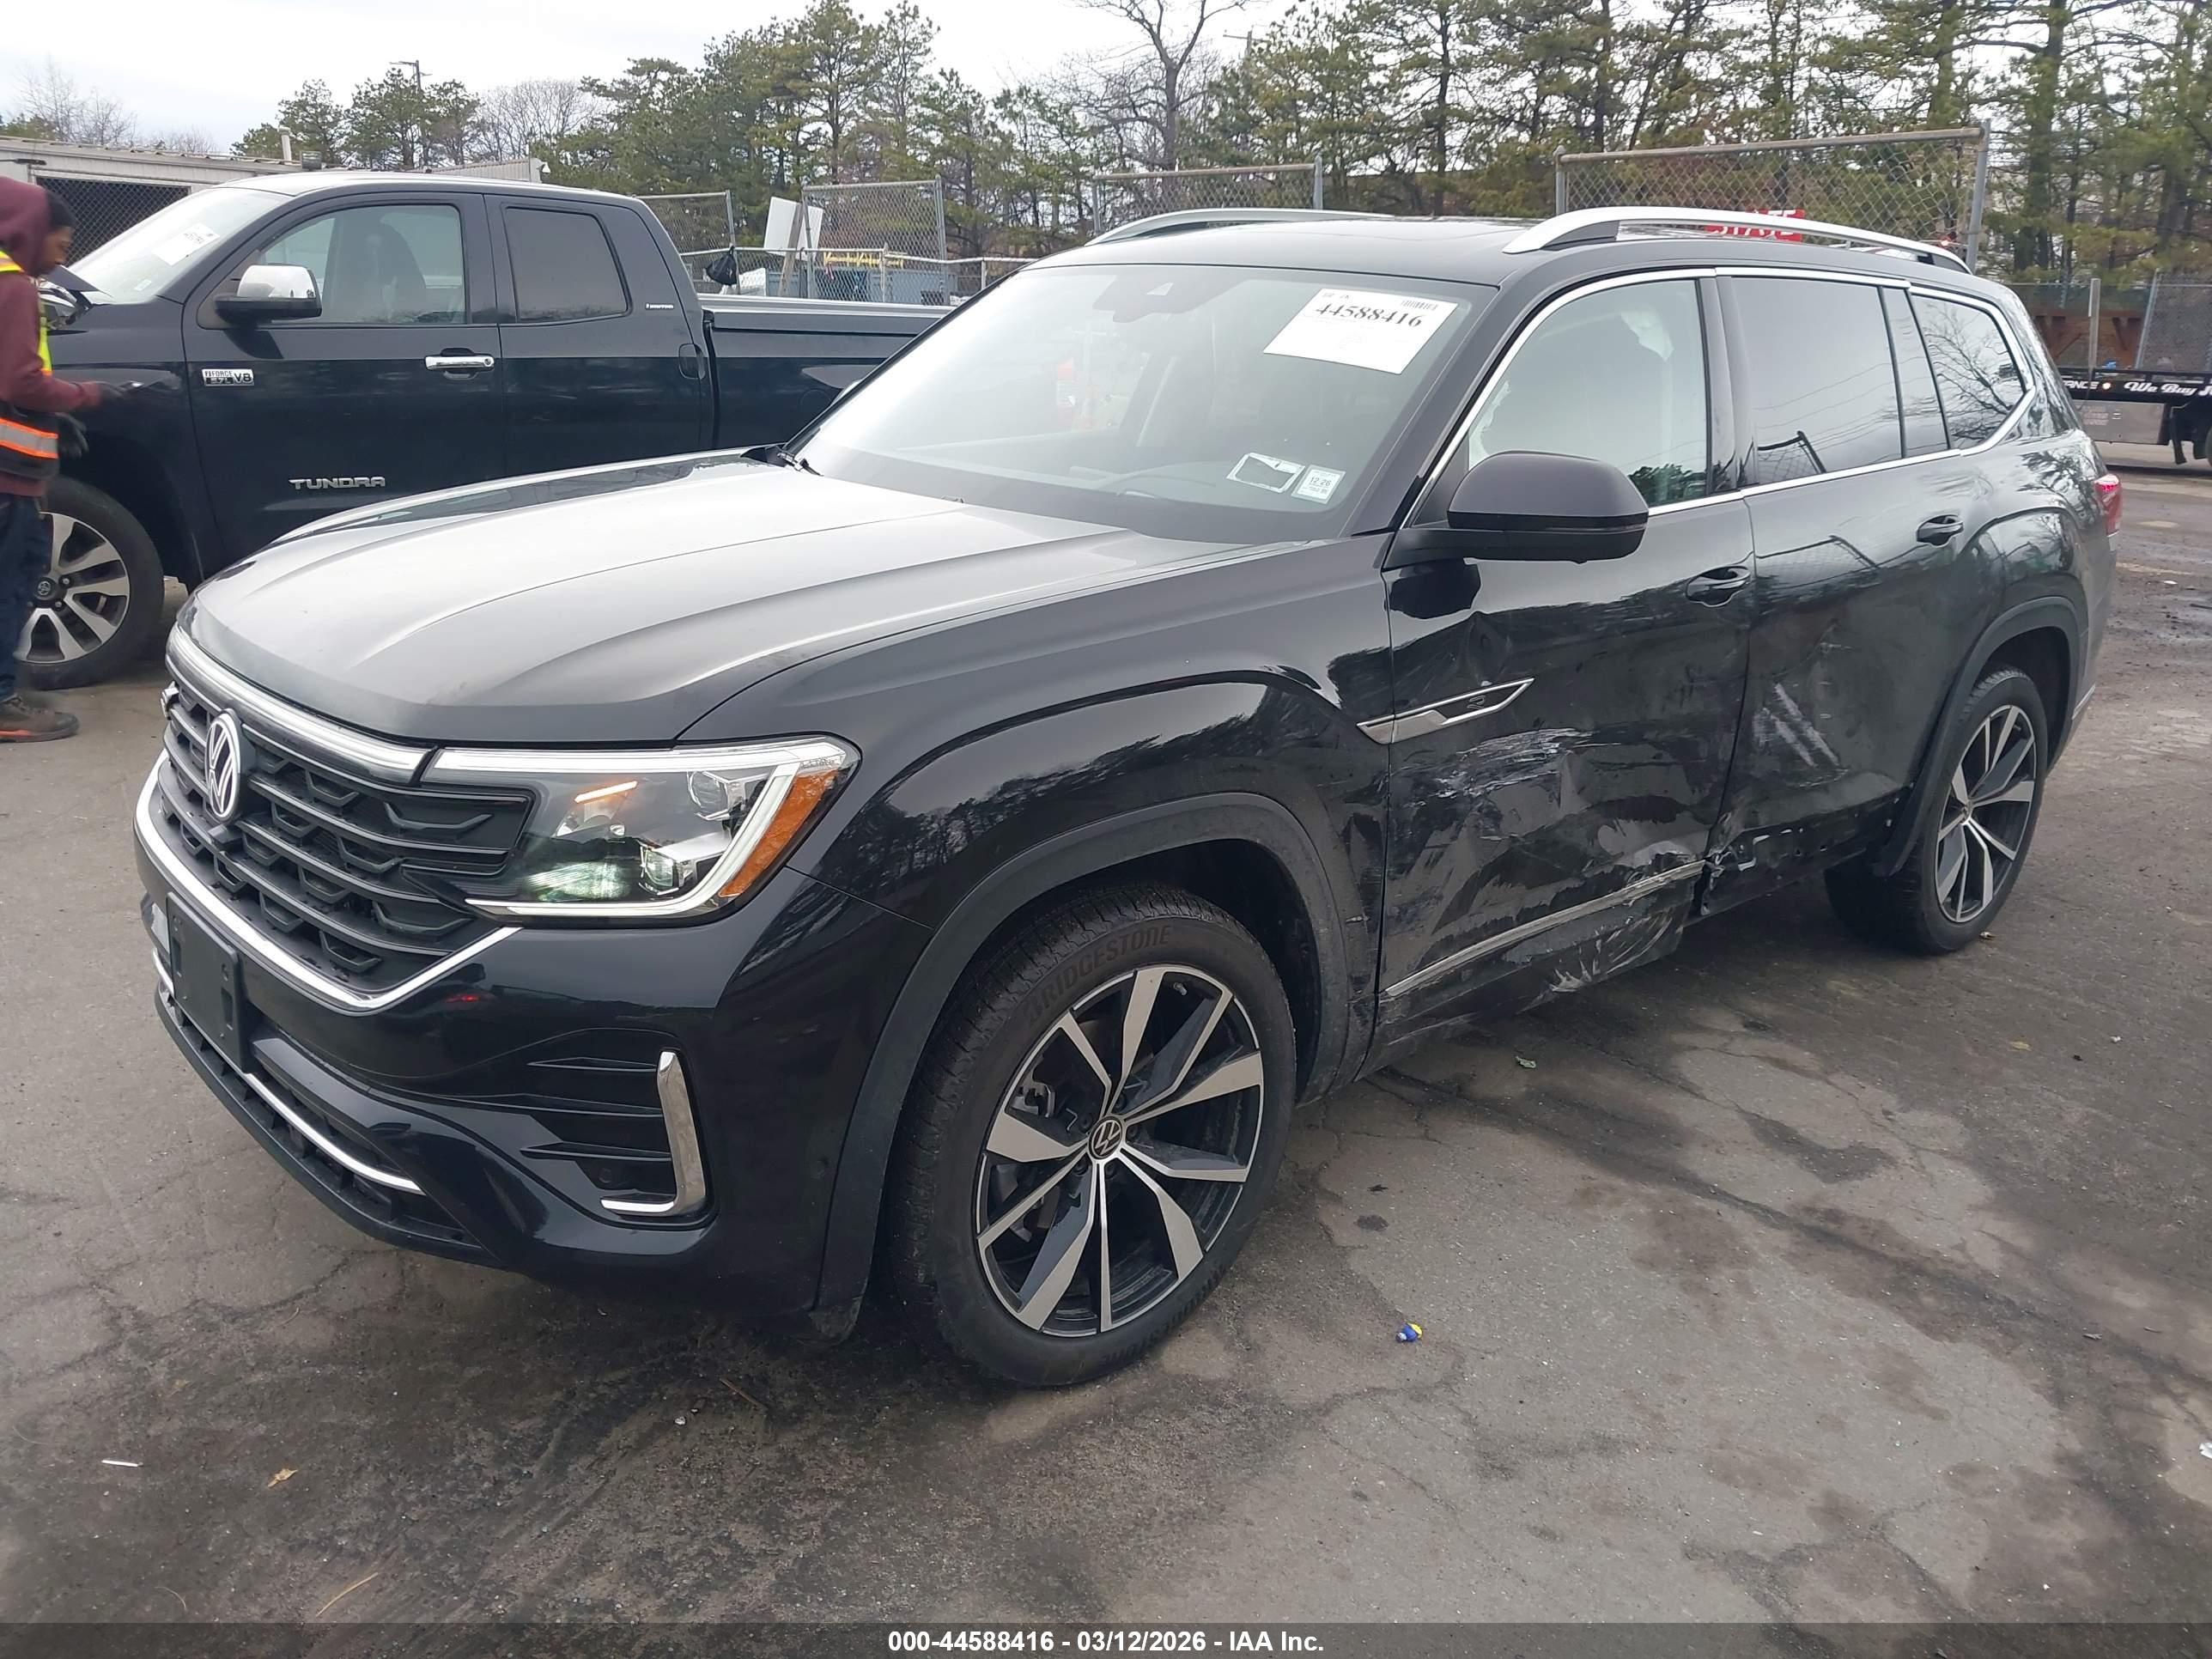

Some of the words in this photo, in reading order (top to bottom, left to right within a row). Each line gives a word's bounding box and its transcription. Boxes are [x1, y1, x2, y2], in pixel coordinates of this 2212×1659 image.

[1316, 303, 1425, 327] 44588416
[234, 373, 252, 384] V8
[2124, 381, 2158, 392] We
[2160, 383, 2198, 396] Buy
[289, 477, 386, 489] TUNDRA
